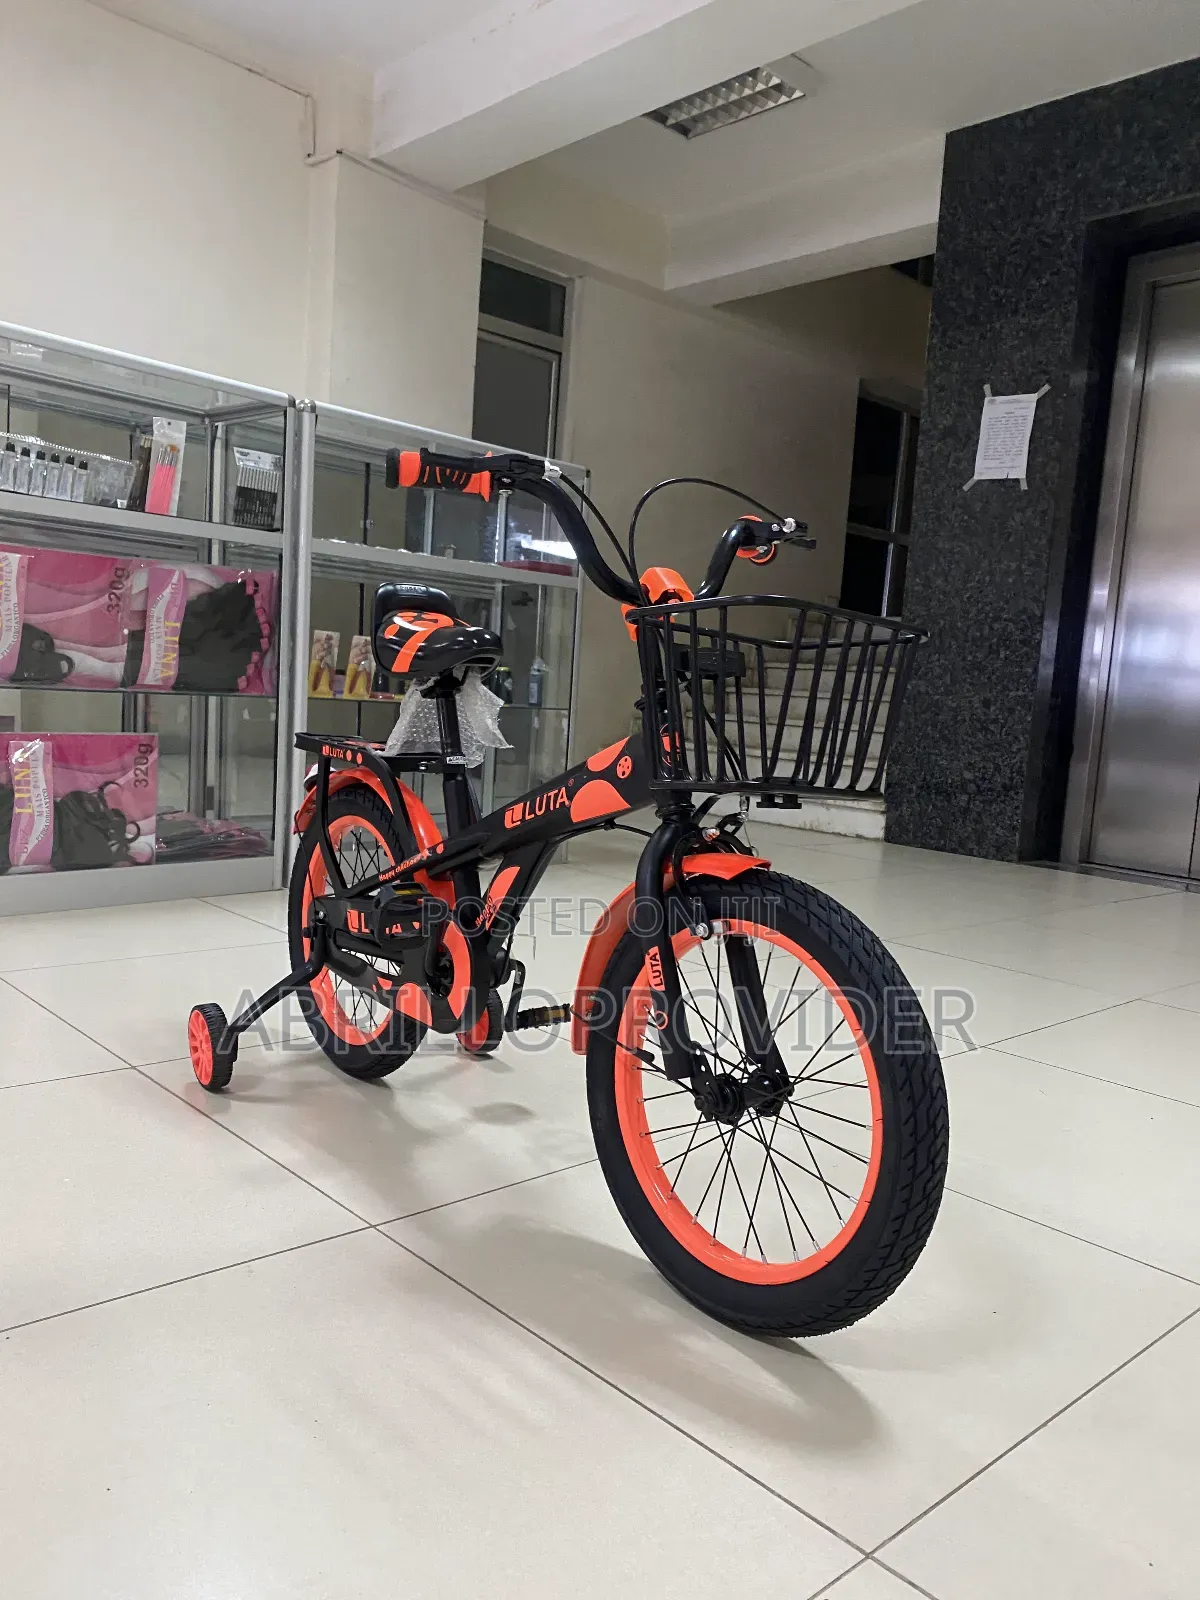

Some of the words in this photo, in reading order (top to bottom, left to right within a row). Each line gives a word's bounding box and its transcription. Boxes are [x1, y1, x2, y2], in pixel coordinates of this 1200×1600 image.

[106, 566, 131, 614] 320g
[133, 743, 154, 789] 320g
[330, 746, 344, 759] LUTA
[525, 786, 571, 821] LUTA
[650, 952, 664, 987] LUTA
